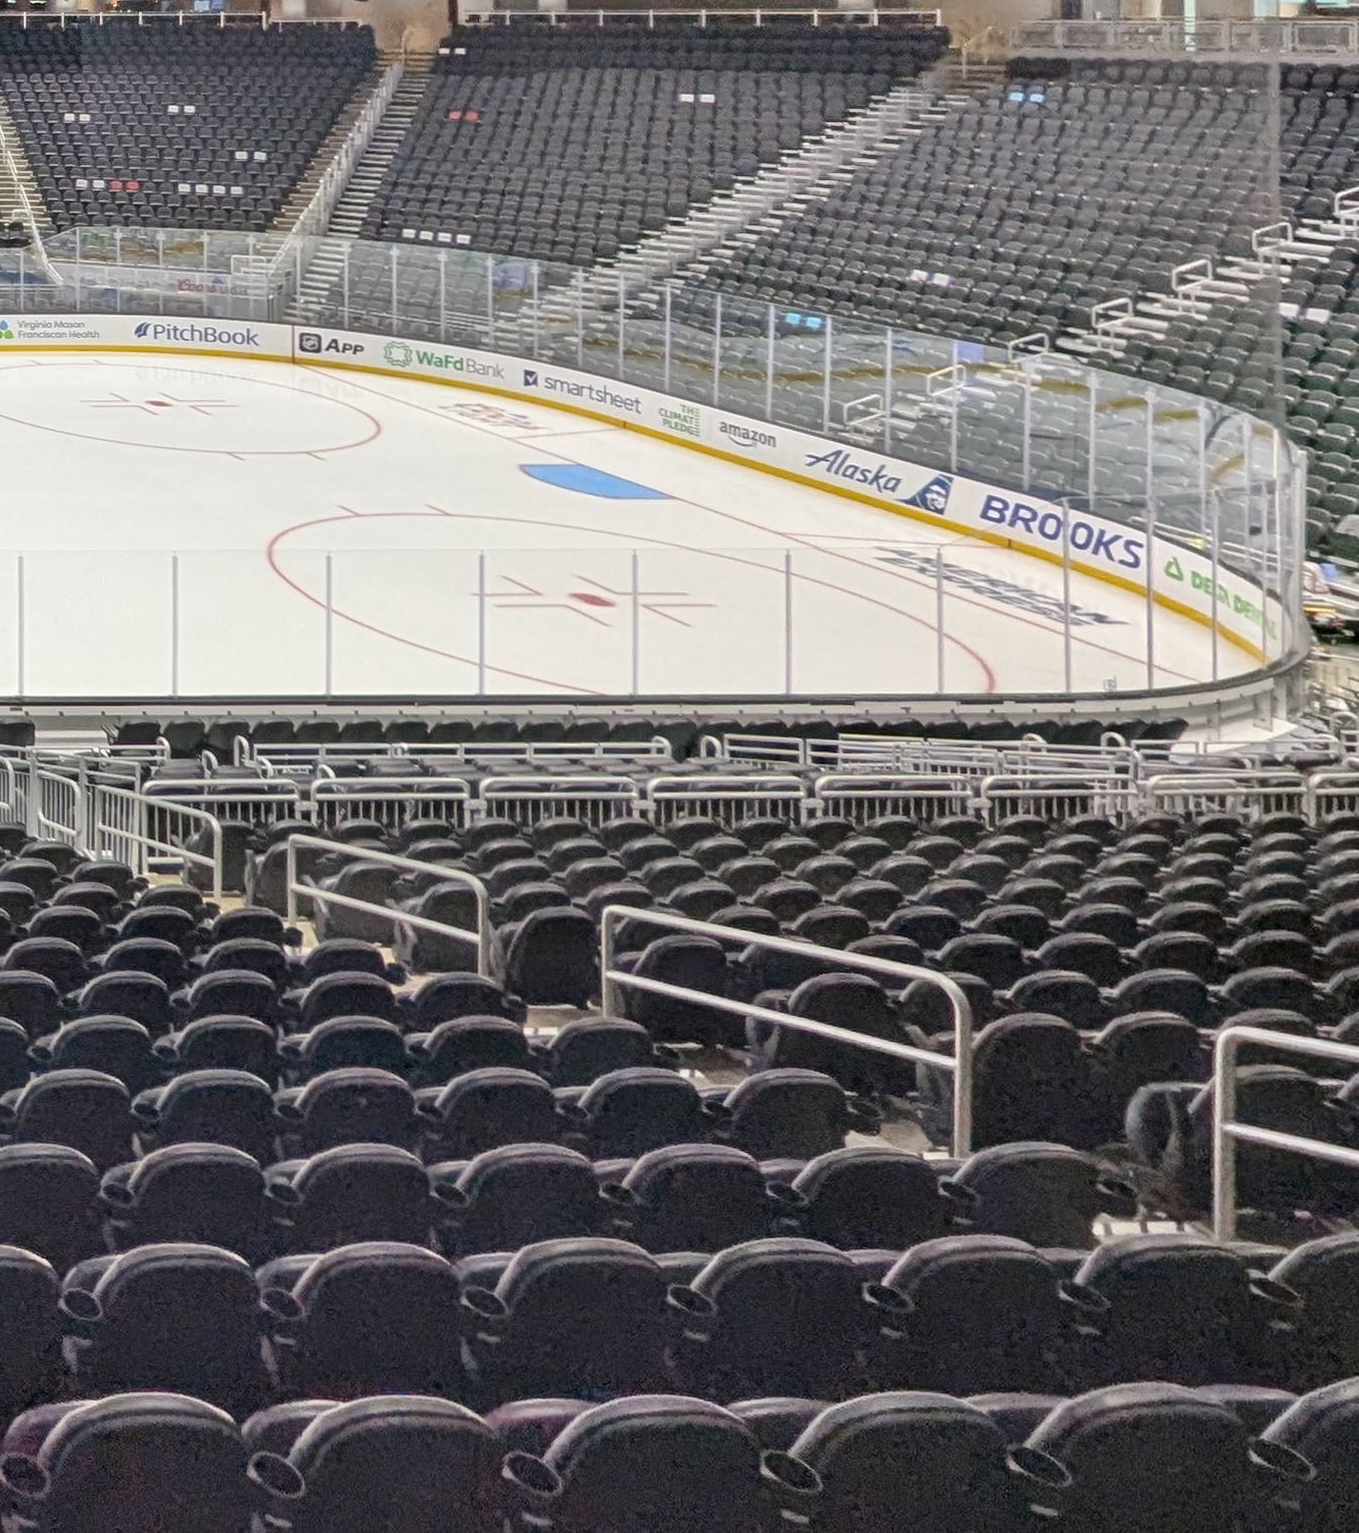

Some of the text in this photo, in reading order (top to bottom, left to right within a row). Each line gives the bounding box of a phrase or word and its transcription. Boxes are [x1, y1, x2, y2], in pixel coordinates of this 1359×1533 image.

[18, 320, 85, 330] Virginia Mason
[18, 330, 100, 339] Franciscan Health
[153, 324, 260, 347] PitchBook
[415, 351, 505, 379] WaFd Bank
[544, 373, 642, 415] smartsheet
[658, 407, 700, 427] CLIMATE
[680, 404, 700, 418] THE
[662, 418, 700, 437] PLEDGE
[719, 419, 777, 448] amazon
[806, 449, 902, 493] Alaska
[979, 494, 1145, 570] BROOKS
